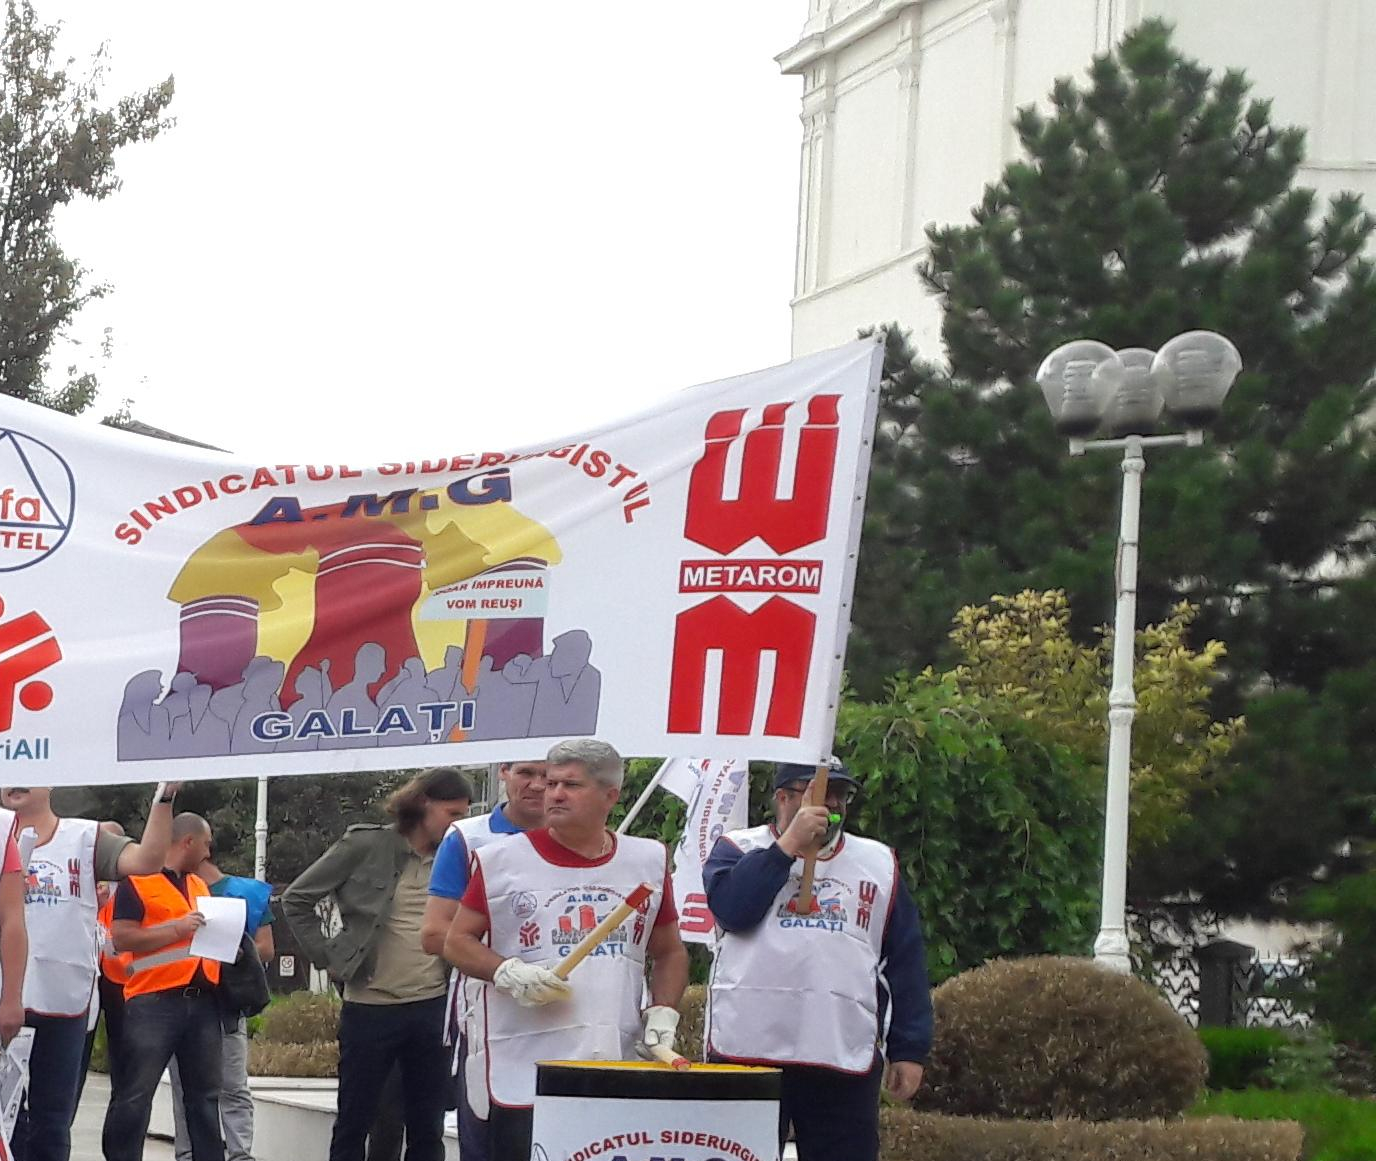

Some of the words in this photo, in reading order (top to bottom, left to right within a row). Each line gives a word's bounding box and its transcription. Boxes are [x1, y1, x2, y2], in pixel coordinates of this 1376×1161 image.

[114, 464, 362, 546] SINDICATUL
[377, 443, 651, 524] SIDERGISTUL
[250, 467, 511, 525] A.M.G
[472, 576, 544, 591] ÎMPREUNĂ
[684, 564, 820, 587] METAROM
[446, 600, 478, 610] VOM
[251, 702, 476, 742] GALAȚI
